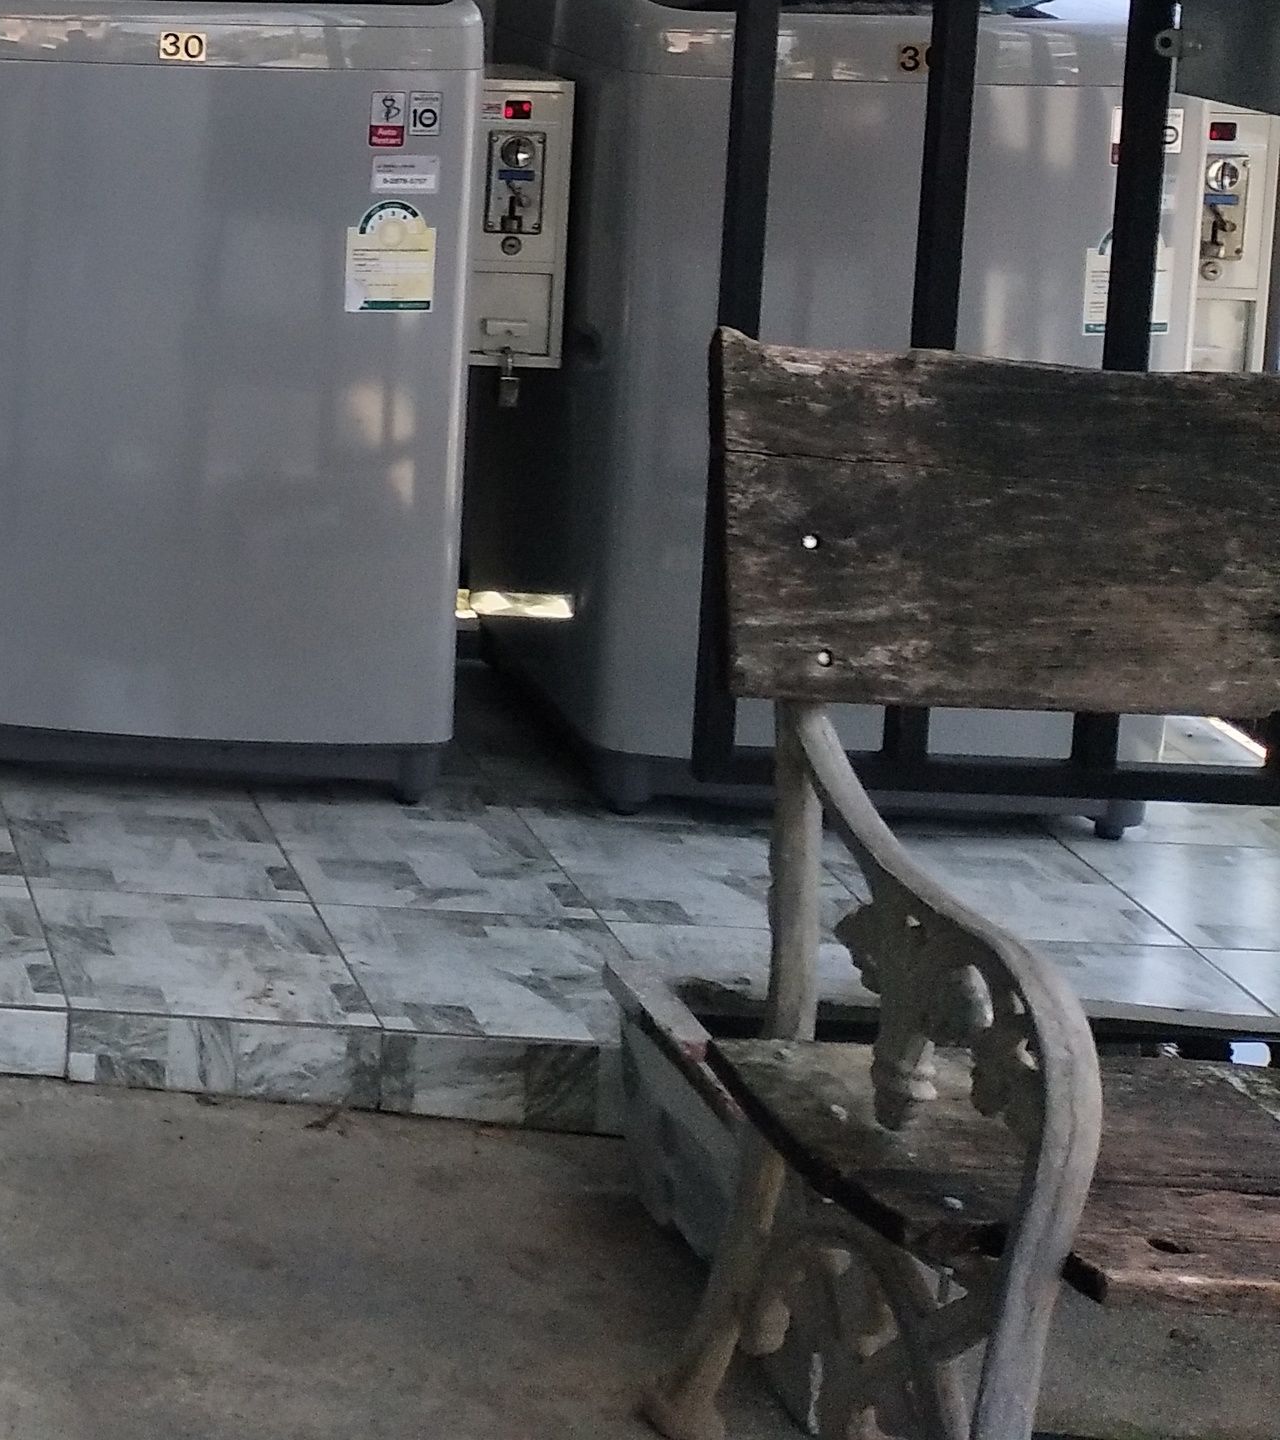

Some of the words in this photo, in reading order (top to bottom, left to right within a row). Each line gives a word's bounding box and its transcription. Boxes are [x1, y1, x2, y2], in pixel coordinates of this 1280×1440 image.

[161, 32, 204, 59] 30
[900, 45, 931, 72] 3
[412, 108, 438, 128] 10
[377, 127, 398, 136] Auto
